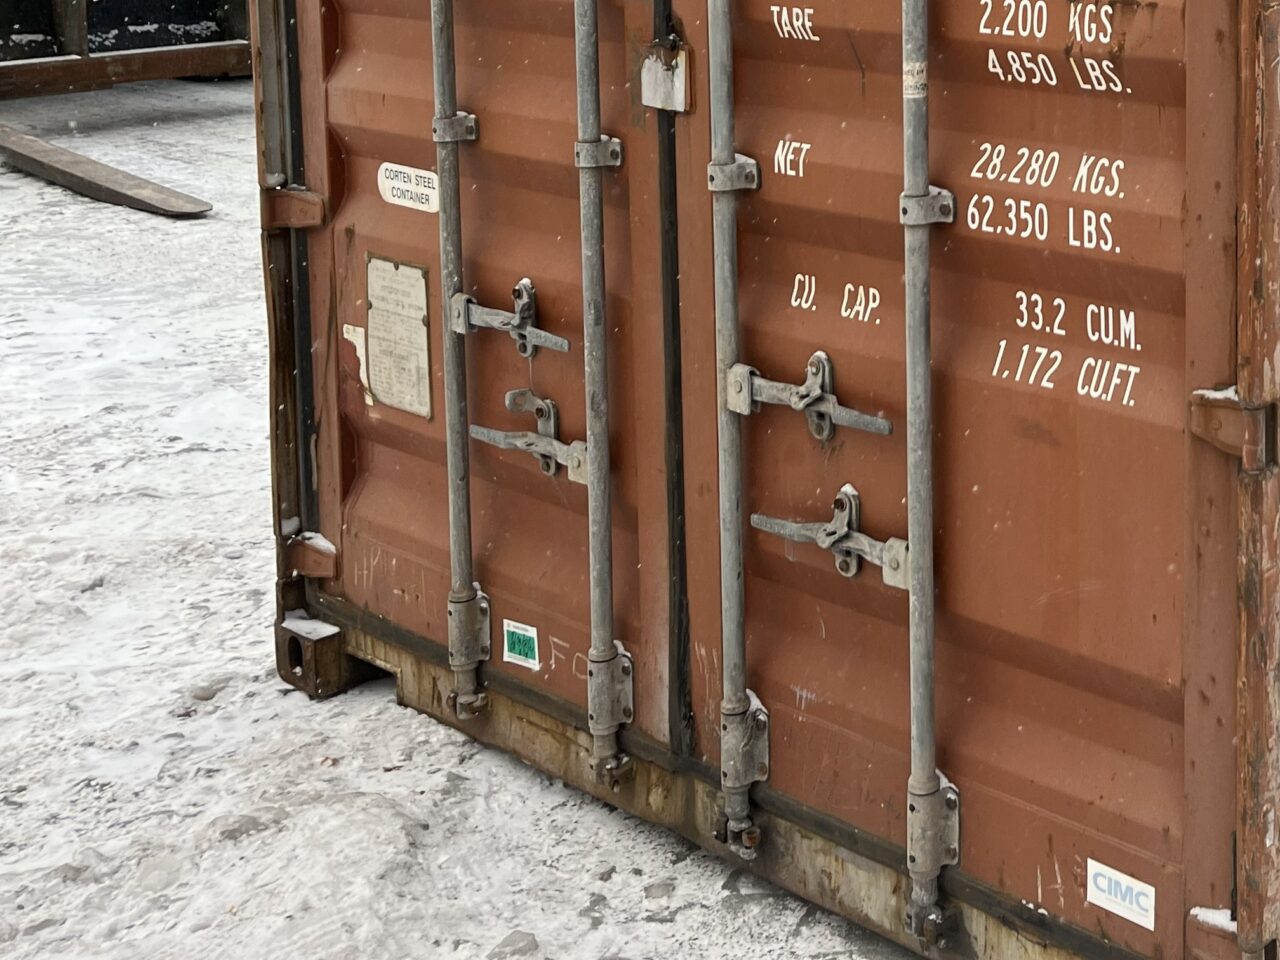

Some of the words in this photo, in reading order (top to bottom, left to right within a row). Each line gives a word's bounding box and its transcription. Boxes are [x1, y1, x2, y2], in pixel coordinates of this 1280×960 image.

[770, 5, 820, 41] TARE
[1069, 57, 1132, 94] LBS.
[384, 168, 412, 184] CORTEN
[415, 174, 436, 190] STEEL
[774, 139, 811, 178] NET
[1072, 154, 1125, 199] KGS.
[391, 186, 430, 205] CONTAINER
[1068, 207, 1121, 254] LBS.
[790, 273, 816, 311] CU.
[840, 282, 881, 325] CAP.
[1015, 290, 1067, 336] 33.2
[1086, 303, 1142, 351] CU.M.
[1092, 870, 1150, 913] CIMC
